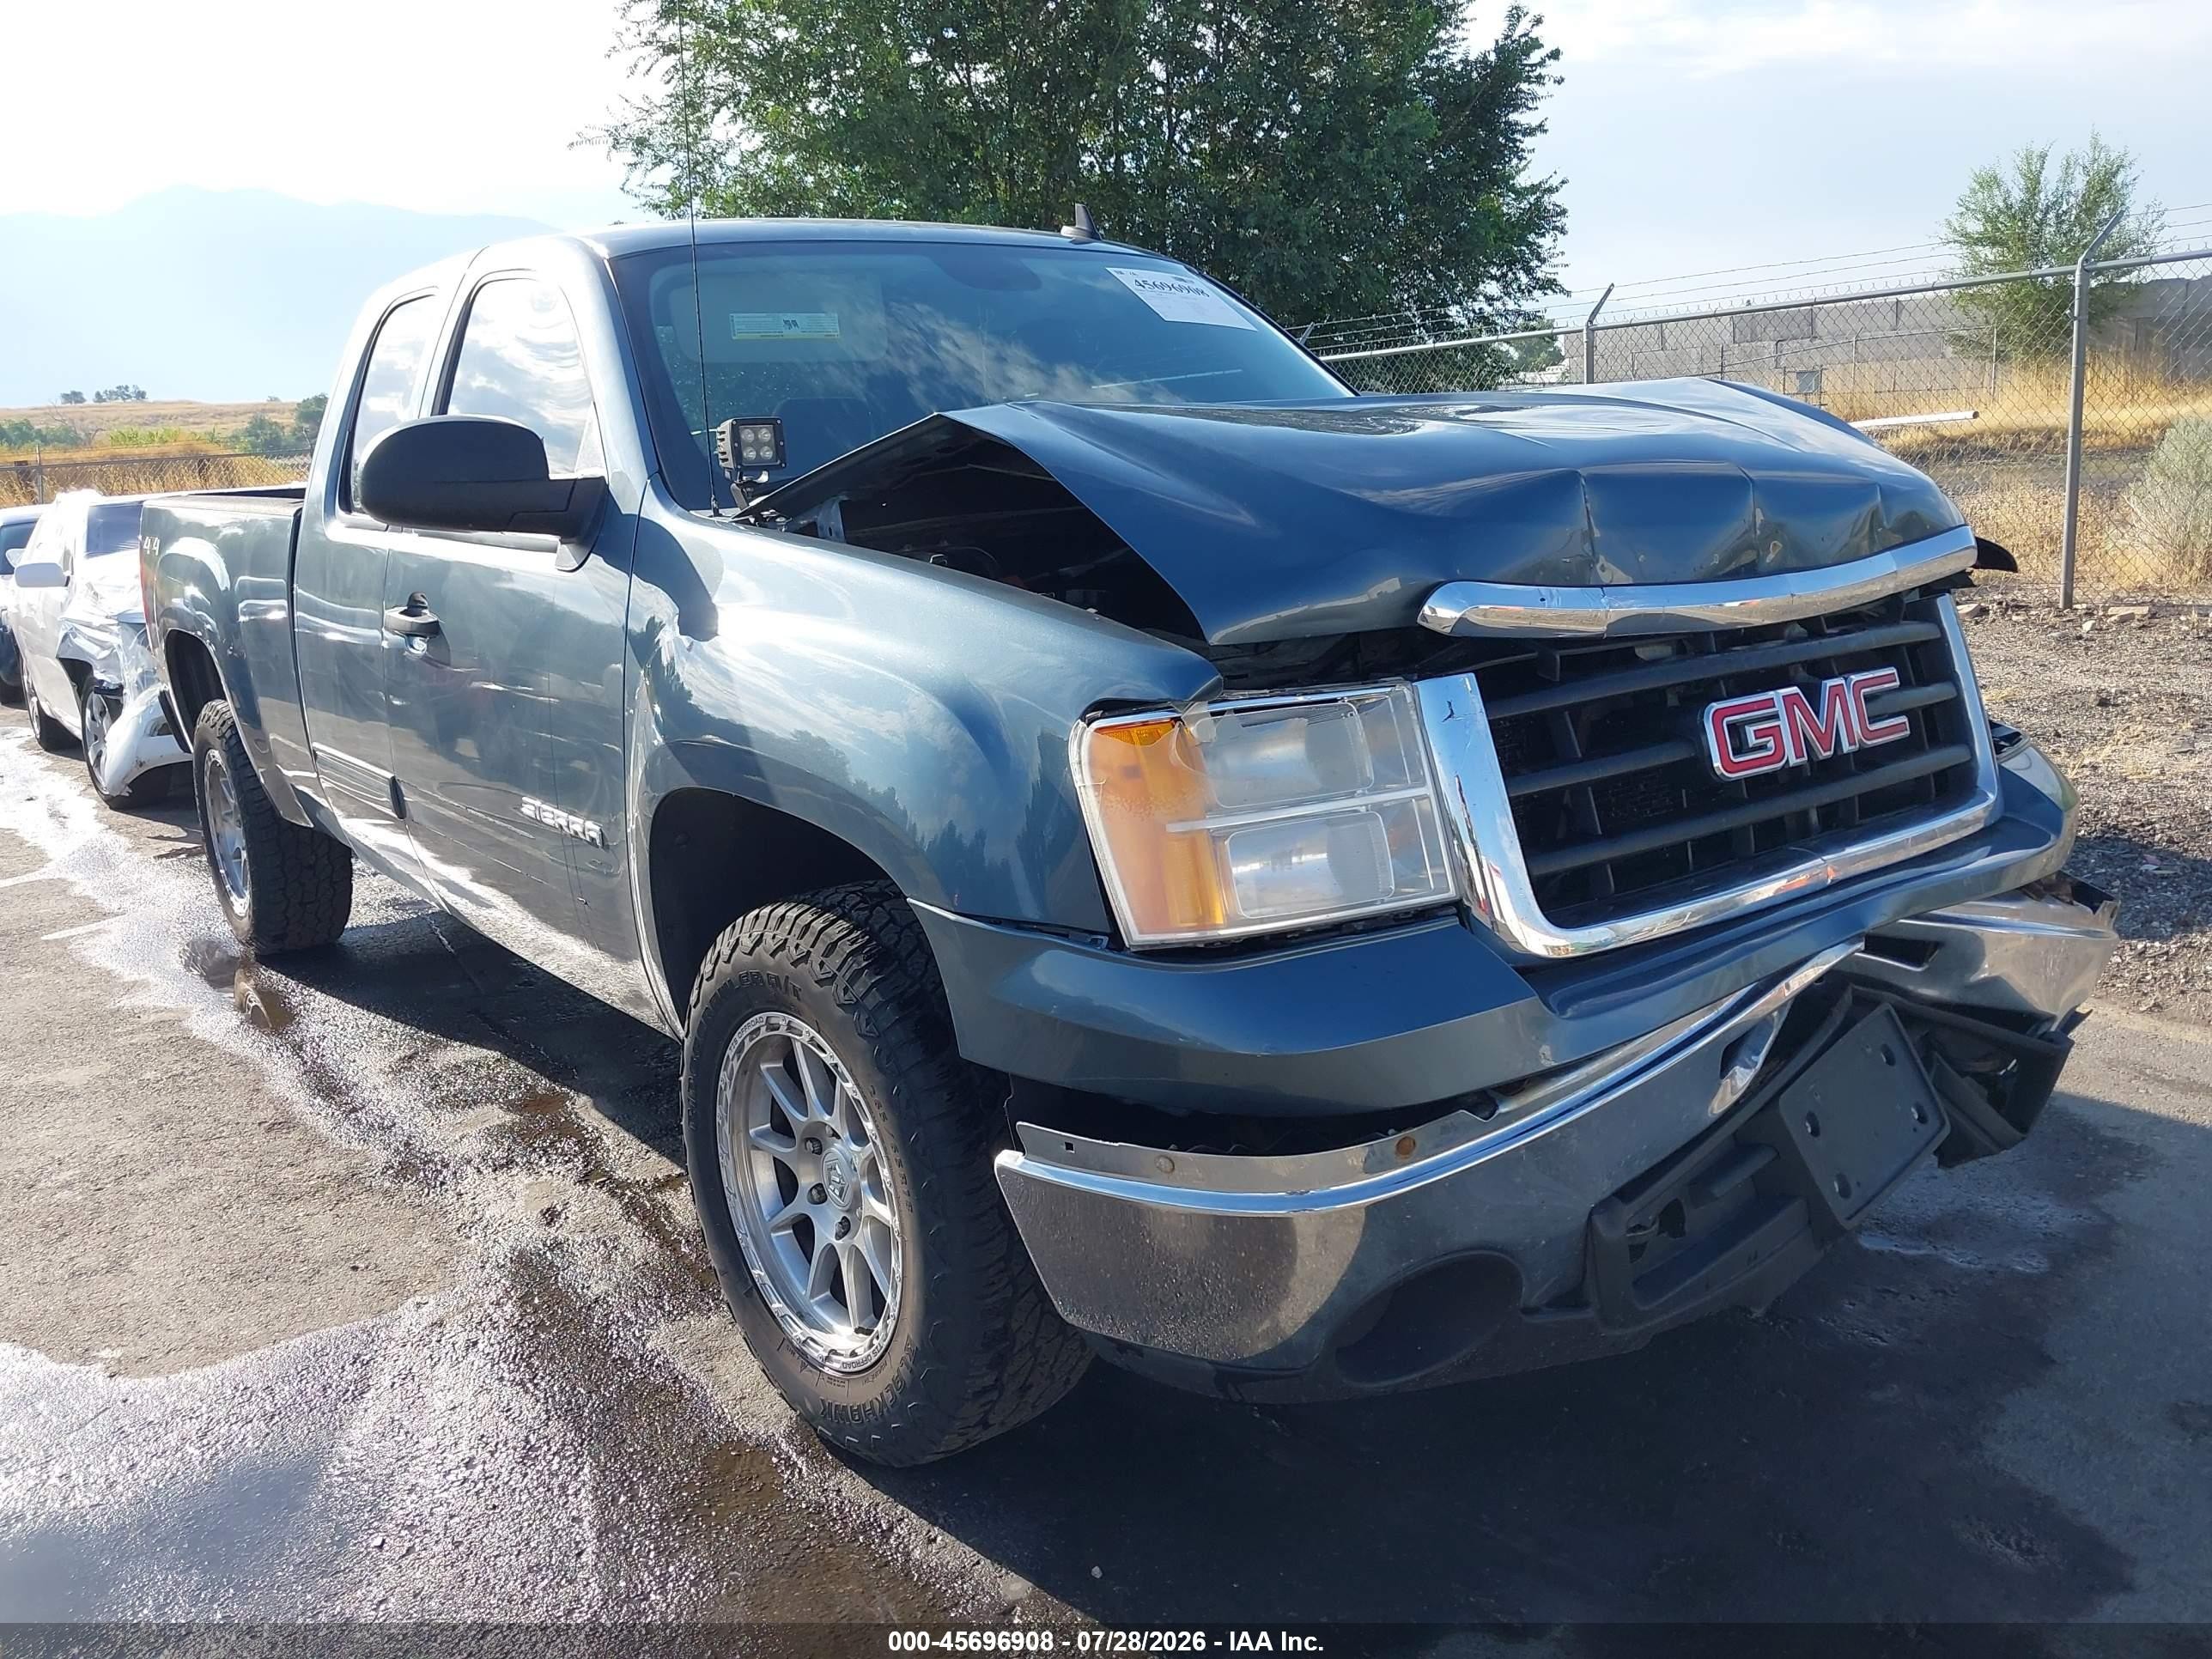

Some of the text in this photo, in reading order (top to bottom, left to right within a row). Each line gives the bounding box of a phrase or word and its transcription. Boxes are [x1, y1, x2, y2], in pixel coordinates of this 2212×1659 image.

[1134, 279, 1210, 298] 45696908
[1704, 666, 1911, 781] GMC
[521, 796, 601, 848] SIERRA
[738, 1016, 765, 1040] OFFROAD
[842, 1342, 884, 1370] TIS OFFROAD
[817, 1334, 920, 1425] BLACKHAWK
